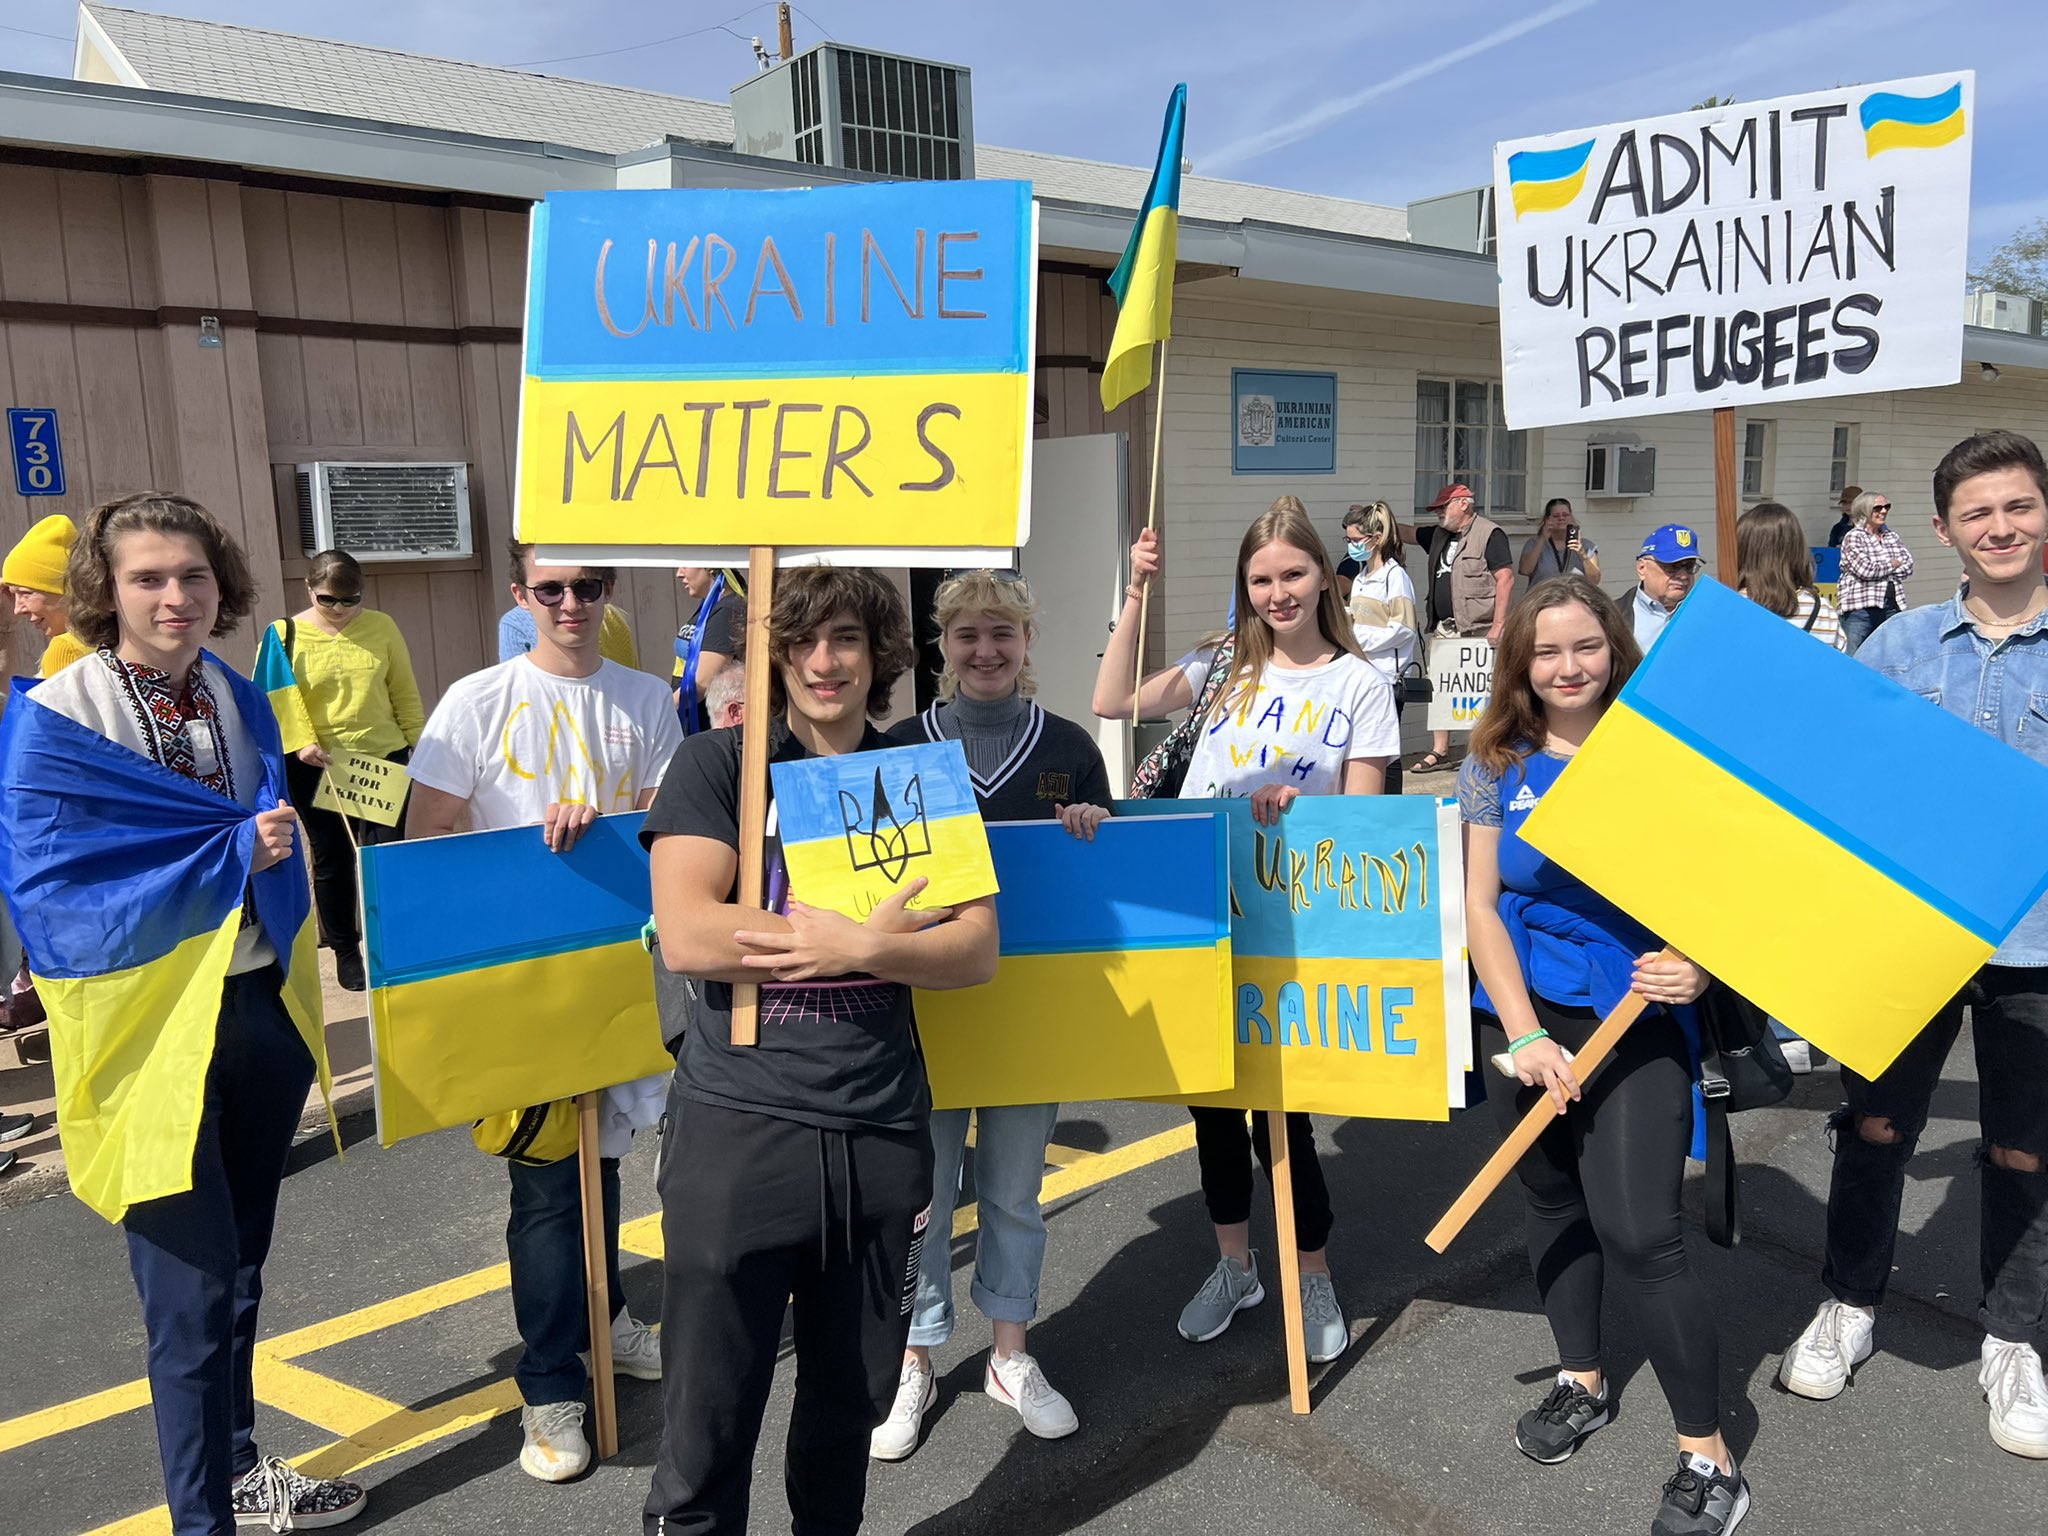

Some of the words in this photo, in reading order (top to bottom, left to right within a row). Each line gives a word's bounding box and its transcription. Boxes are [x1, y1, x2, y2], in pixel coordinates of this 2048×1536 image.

[1588, 104, 1847, 224] ADMIT
[1527, 185, 1896, 318] UKRAINIAN
[595, 228, 987, 337] UKRAINE
[1576, 293, 1883, 408] REFUGEES
[1276, 402, 1332, 415] UKRAINIAN
[1277, 417, 1330, 429] AMERICAN
[23, 417, 52, 488] 730
[562, 398, 962, 504] MATTERS
[1276, 435, 1306, 443] Cultural
[1307, 435, 1331, 443] Center
[349, 758, 392, 776] PRAY
[1230, 741, 1316, 780] WITH
[325, 785, 395, 812] UKRAINE
[349, 774, 381, 790] FOR
[1037, 772, 1070, 794] ASU
[1254, 829, 1428, 915] UKRAINI
